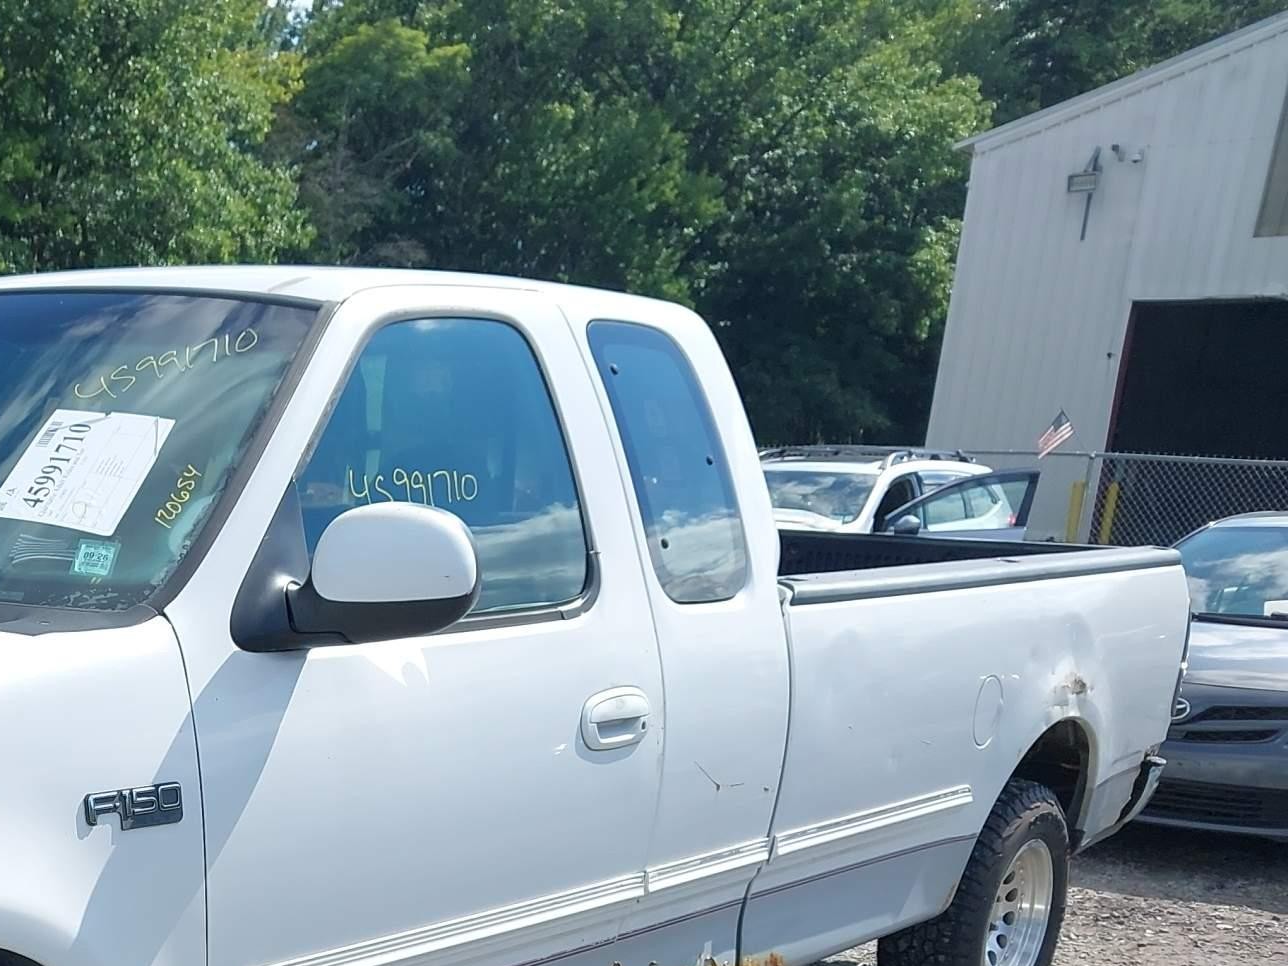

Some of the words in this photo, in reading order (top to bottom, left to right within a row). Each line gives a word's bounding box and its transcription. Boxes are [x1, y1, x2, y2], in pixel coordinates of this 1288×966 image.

[74, 328, 258, 399] 45991710
[22, 424, 92, 509] 45991710
[349, 468, 478, 507] 45991710
